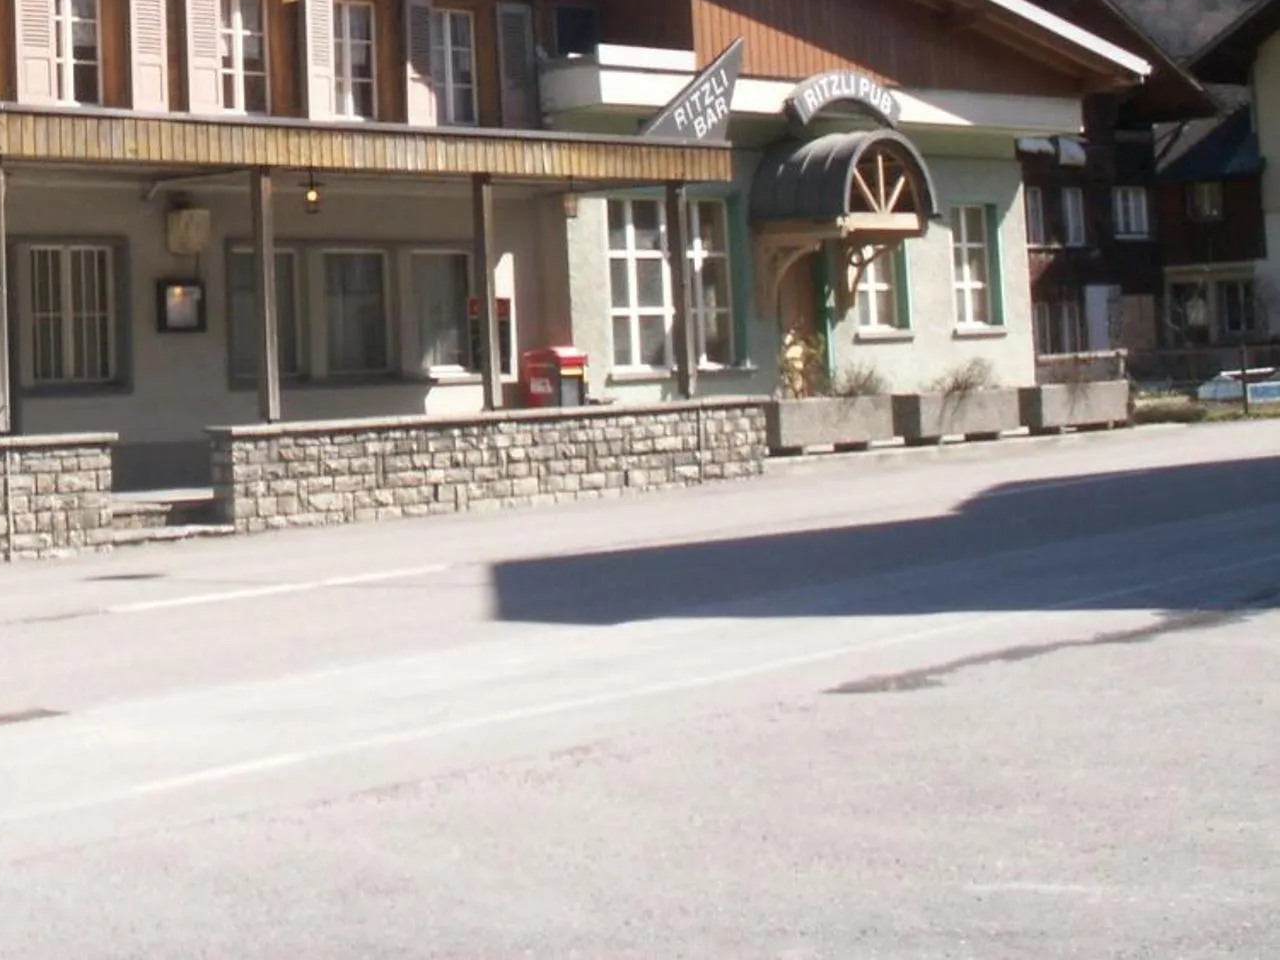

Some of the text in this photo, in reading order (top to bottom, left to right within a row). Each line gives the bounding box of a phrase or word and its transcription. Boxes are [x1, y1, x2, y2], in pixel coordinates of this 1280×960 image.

[674, 68, 728, 132] RITZLI
[803, 76, 892, 115] RITZLI PUB
[693, 96, 729, 139] BAR
